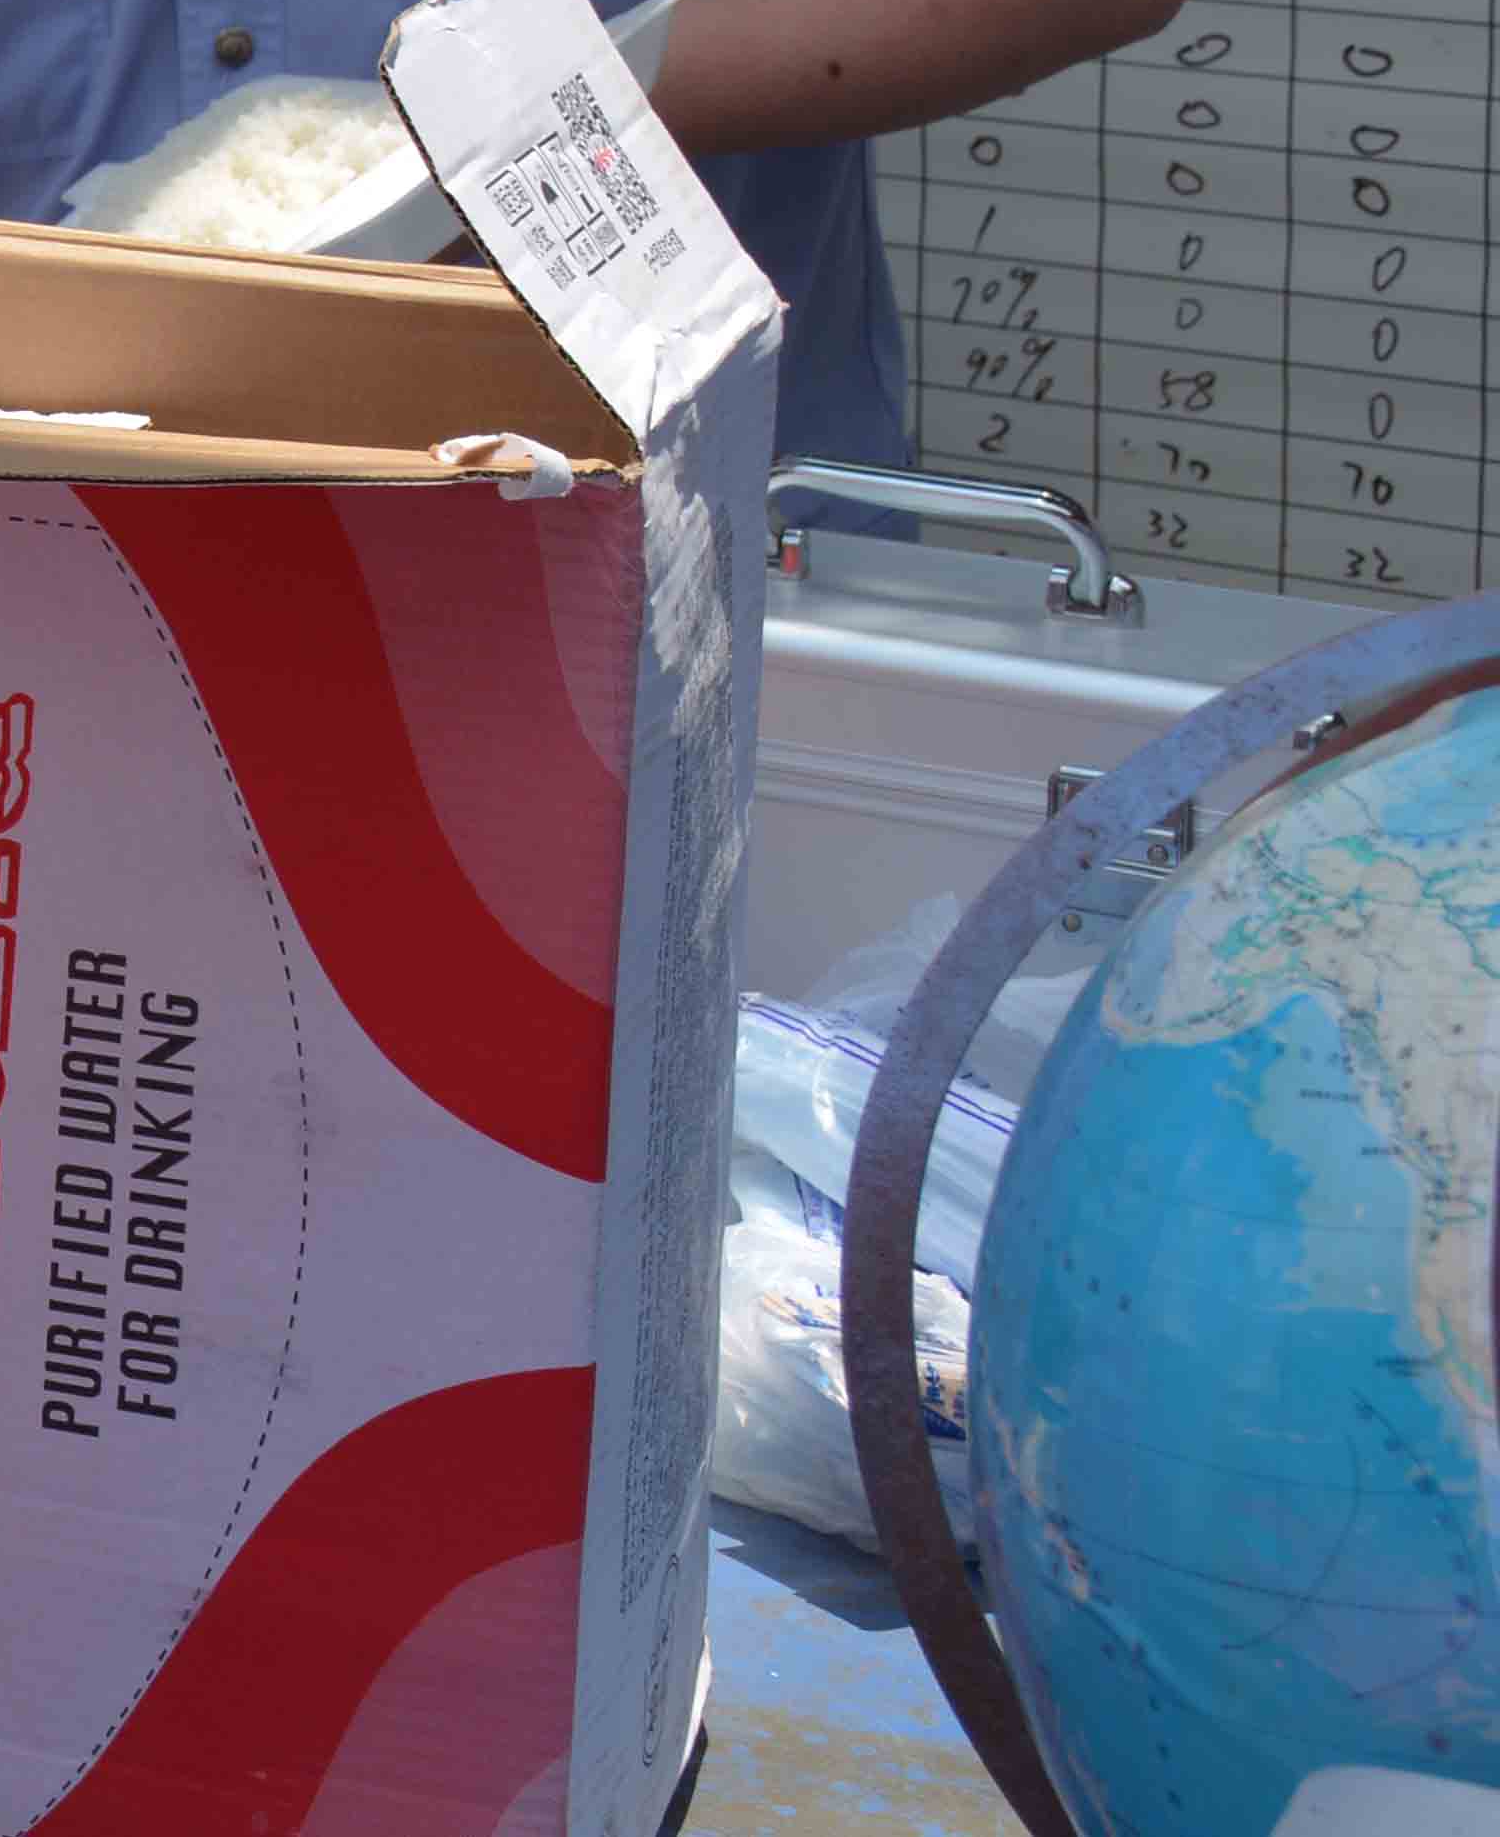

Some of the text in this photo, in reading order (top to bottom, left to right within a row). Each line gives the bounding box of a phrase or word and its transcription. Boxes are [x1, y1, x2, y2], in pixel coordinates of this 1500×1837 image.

[1160, 370, 1217, 412] 58
[979, 414, 1010, 453] 2
[1147, 510, 1189, 549] 32
[1346, 547, 1403, 582] 32
[41, 948, 128, 1438] PURIFIED WATER
[116, 991, 199, 1419] FOR DRINKING
